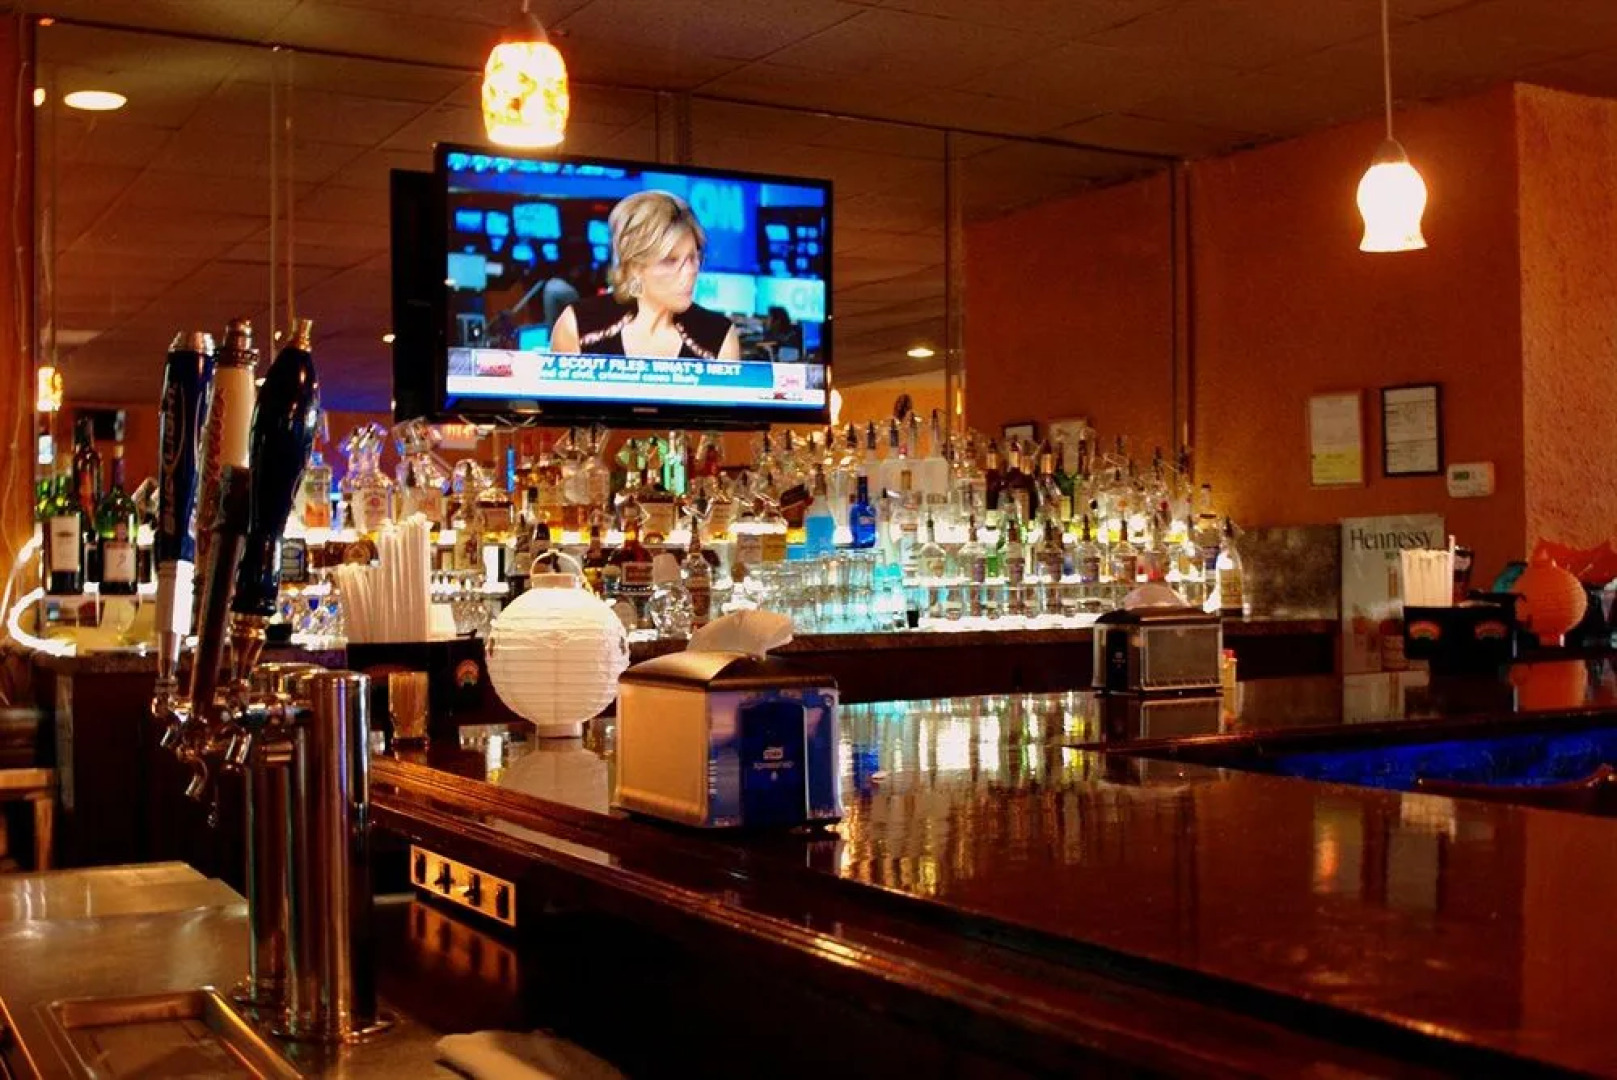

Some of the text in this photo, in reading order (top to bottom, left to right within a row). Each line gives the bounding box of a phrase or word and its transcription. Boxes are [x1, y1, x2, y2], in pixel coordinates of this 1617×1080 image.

[558, 357, 607, 371] SCOUT
[651, 360, 705, 375] WHAT'S
[706, 362, 742, 376] NEXT
[1350, 528, 1434, 551] Hennessy
